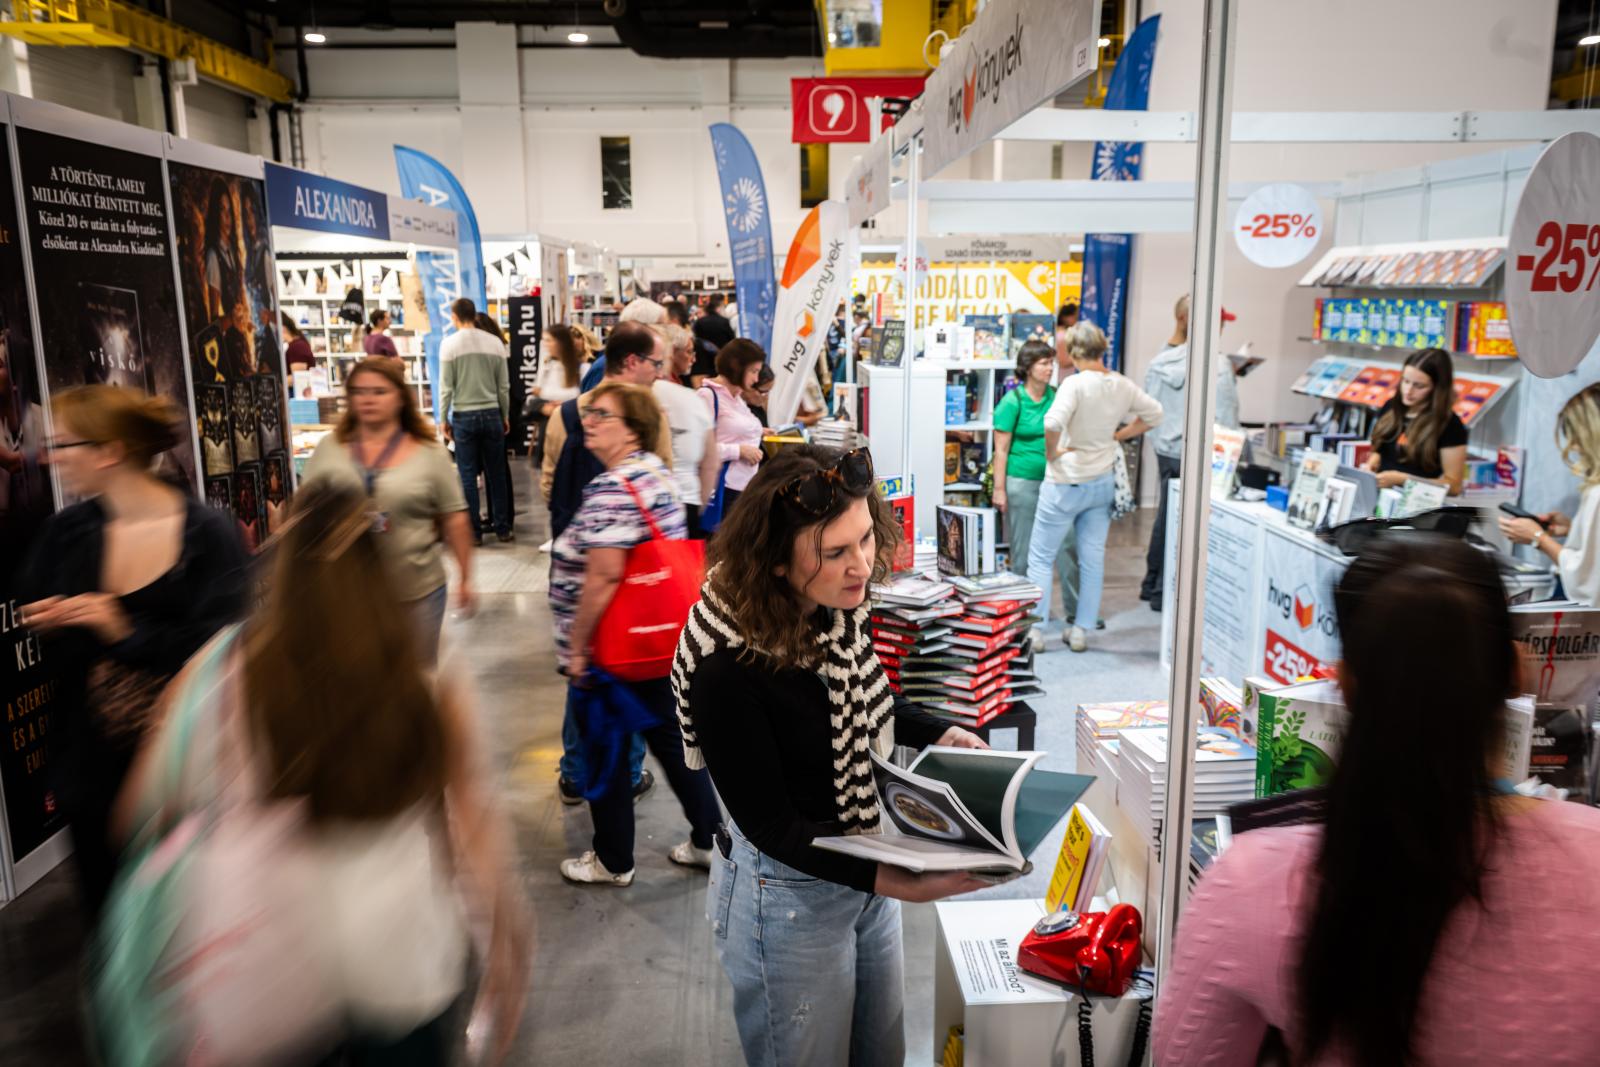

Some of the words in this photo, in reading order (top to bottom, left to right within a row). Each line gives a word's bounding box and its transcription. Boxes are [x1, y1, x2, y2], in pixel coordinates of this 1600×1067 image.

[947, 85, 963, 135] hvg
[976, 13, 1024, 104] könyvek
[50, 166, 58, 181] A
[59, 166, 115, 192] TÖRTÉNET,
[116, 178, 146, 195] AMELY
[31, 185, 92, 208] MILLIÓKAT
[94, 192, 140, 214] ÉRINTETT
[141, 202, 163, 217] MEG.
[294, 185, 377, 229] ALEXANDRA
[38, 210, 65, 227] Közel
[67, 214, 78, 228] 20
[79, 215, 89, 230] év
[90, 217, 109, 231] után
[110, 218, 120, 233] itt
[120, 224, 126, 233] a
[126, 219, 157, 238] folytatás
[1241, 213, 1317, 238] -25%
[42, 234, 78, 251] elsőként
[79, 241, 90, 252] az
[90, 238, 130, 254] Alexandra
[782, 340, 807, 374] hvg
[806, 239, 845, 311] könyvek
[89, 347, 136, 372] viskó
[1267, 577, 1292, 619] hvg
[1266, 641, 1315, 683] -25%
[995, 938, 1008, 949] Mi
[998, 950, 1010, 960] az
[1002, 961, 1025, 994] álmod?
